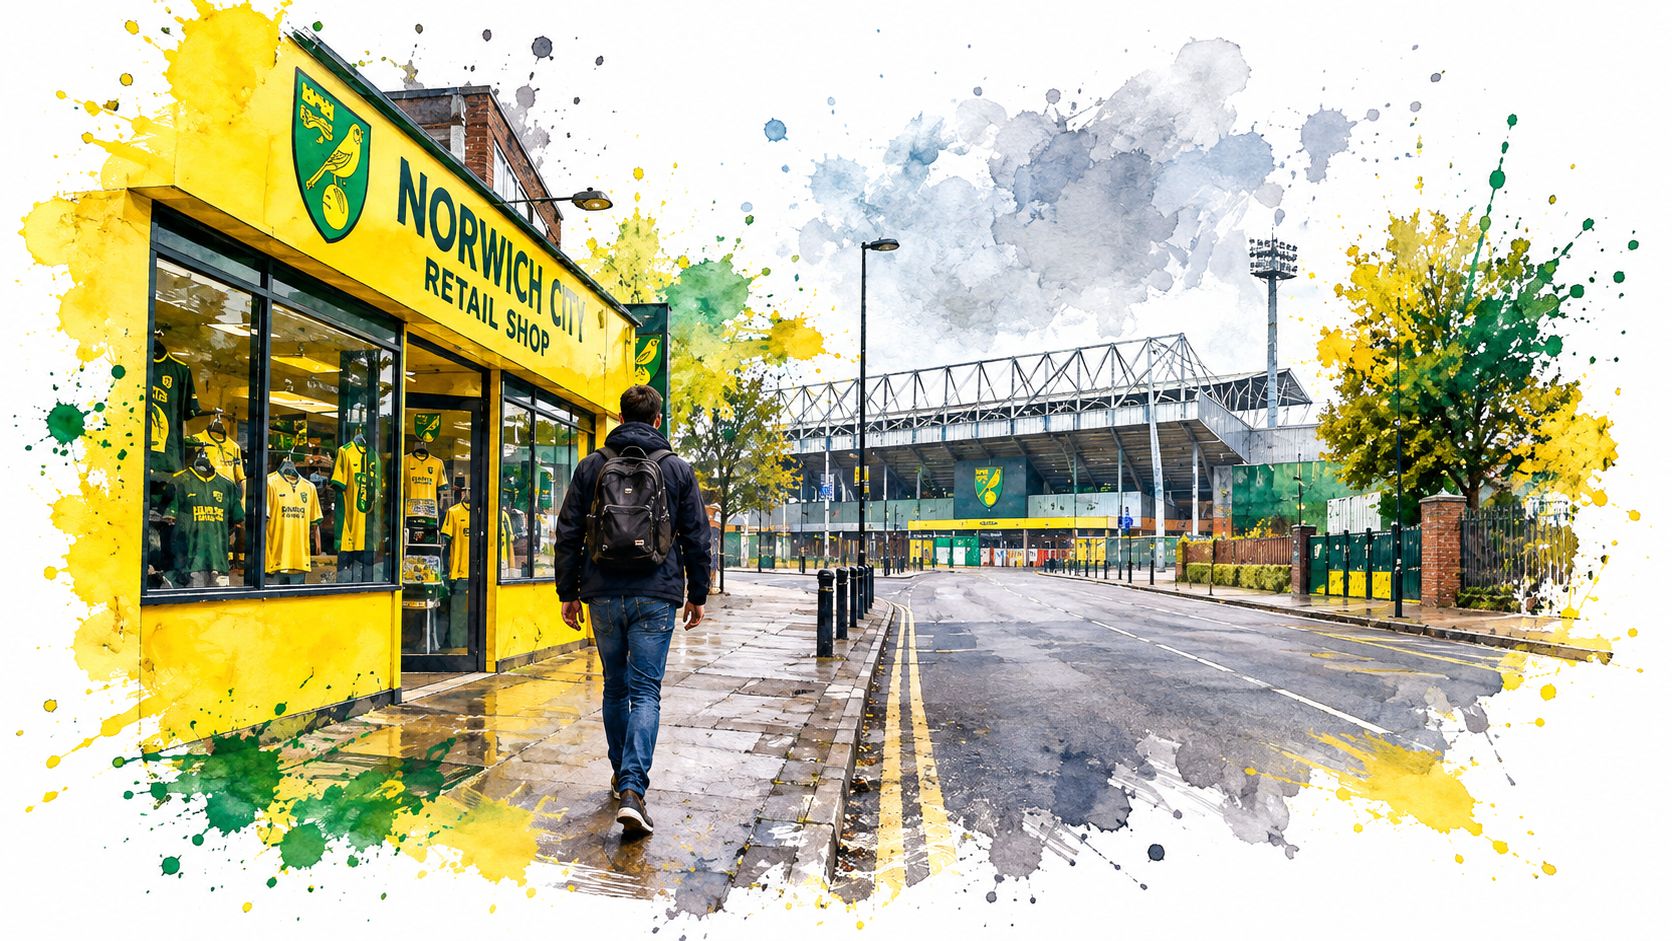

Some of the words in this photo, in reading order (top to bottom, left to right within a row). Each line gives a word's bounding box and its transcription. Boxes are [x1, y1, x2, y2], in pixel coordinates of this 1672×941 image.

[397, 156, 543, 315] NORWICH
[550, 278, 586, 343] CITY
[424, 256, 499, 331] RETAIL
[506, 309, 550, 356] SHOP
